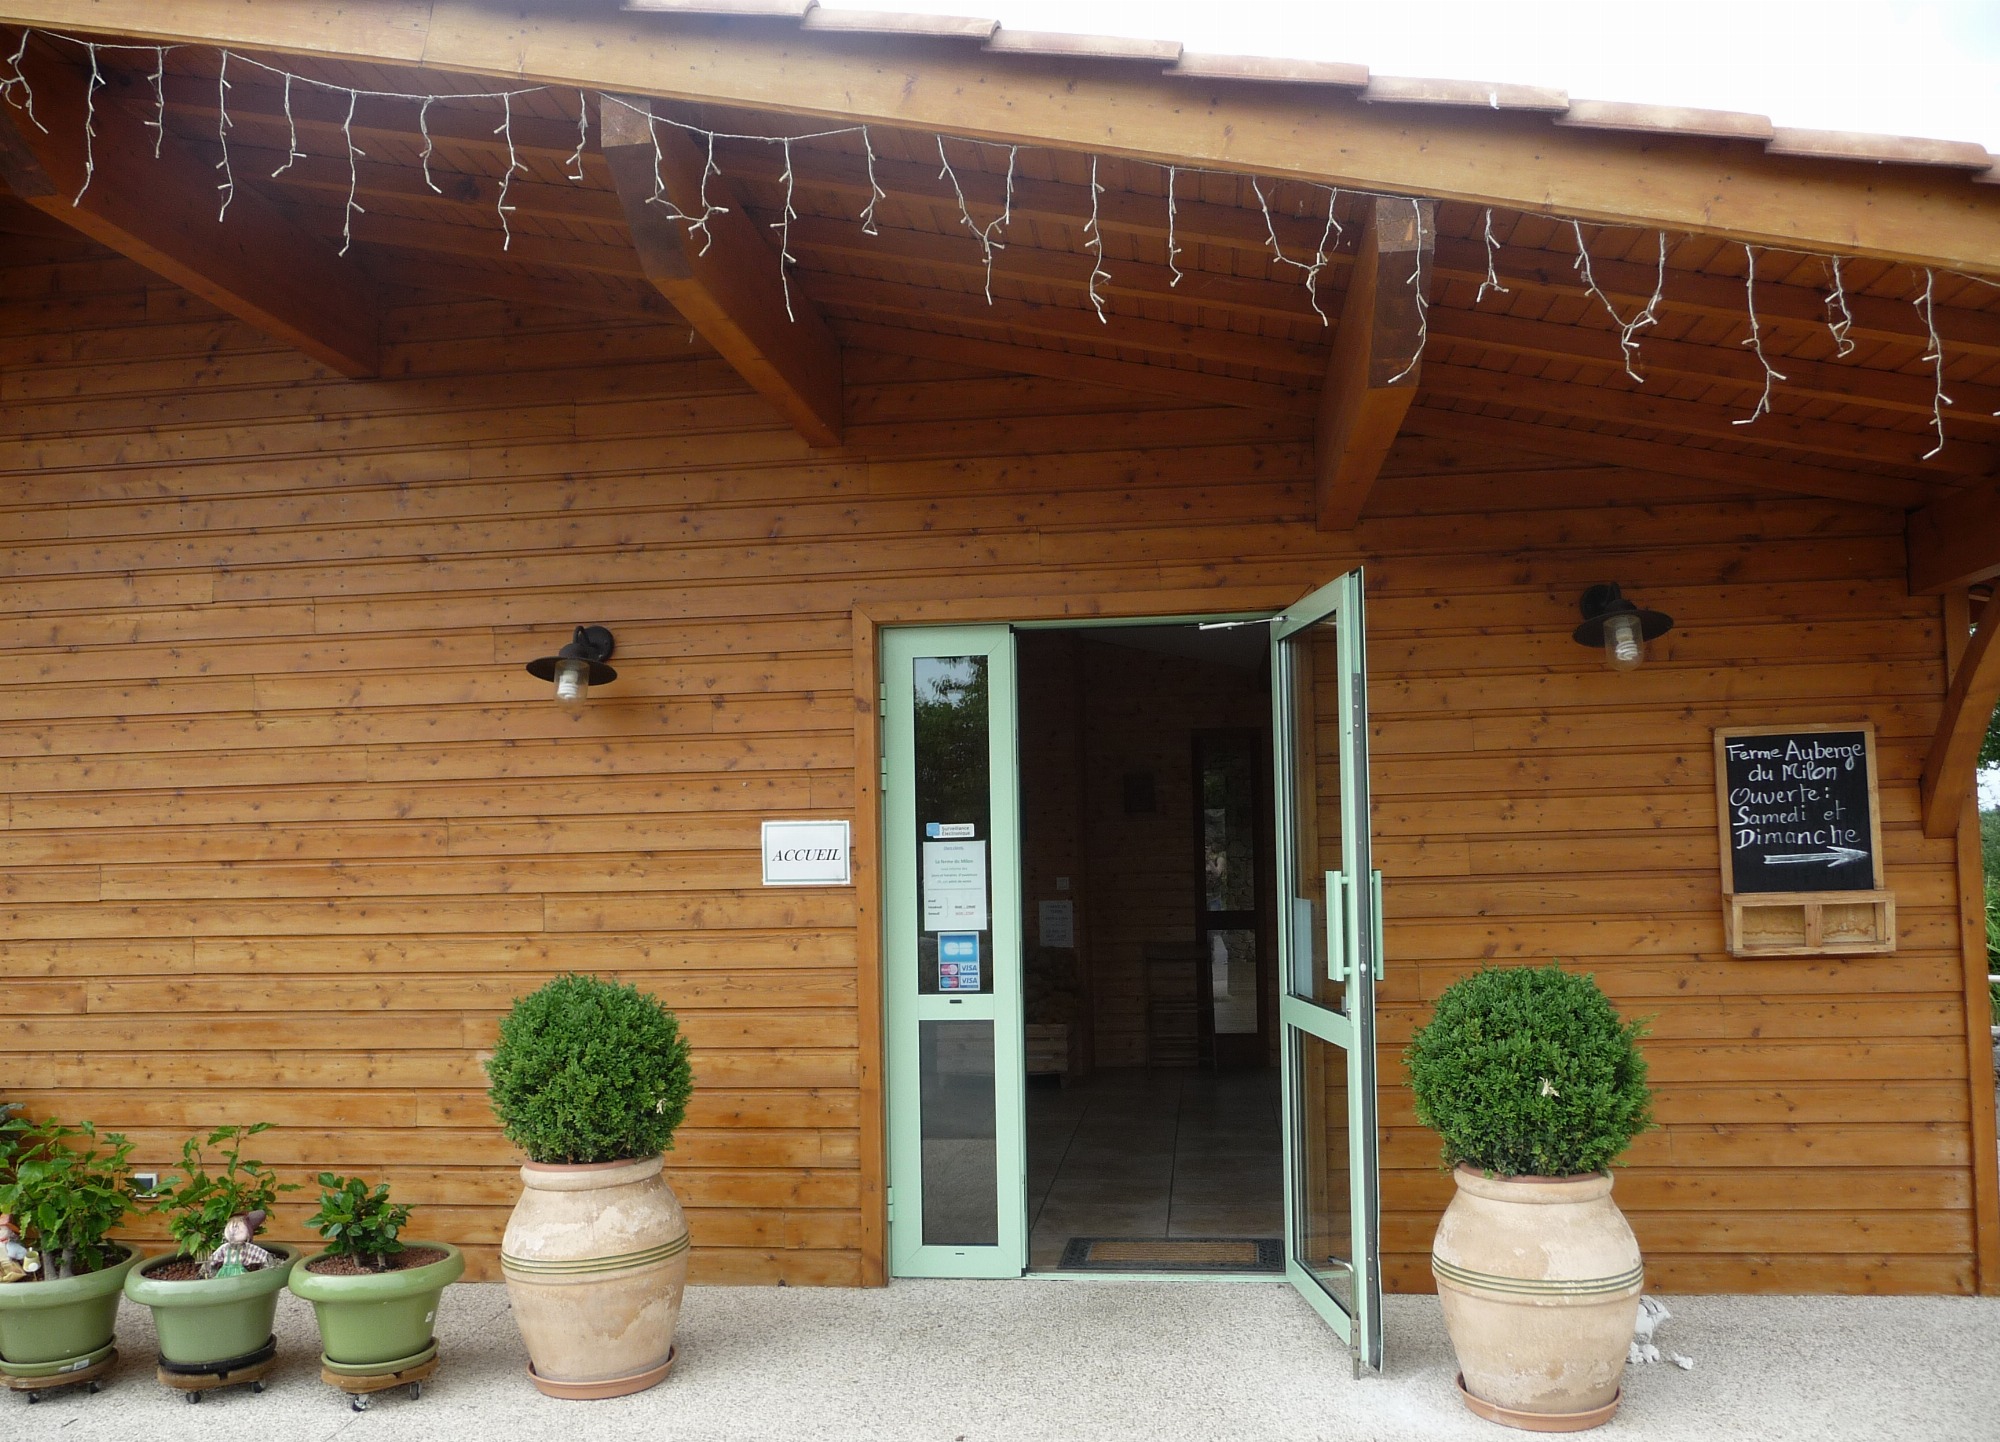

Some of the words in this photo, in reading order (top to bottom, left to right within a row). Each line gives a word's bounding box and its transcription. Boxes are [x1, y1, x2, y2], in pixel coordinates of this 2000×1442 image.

[1725, 743, 1783, 762] Ferme
[1784, 740, 1865, 771] Auberge
[1748, 764, 1773, 781] du
[1782, 762, 1837, 781] Milon
[1733, 805, 1807, 827] Samedi
[1823, 800, 1847, 821] et
[1735, 825, 1861, 850] Dimanche
[772, 848, 842, 862] ACCUEIL
